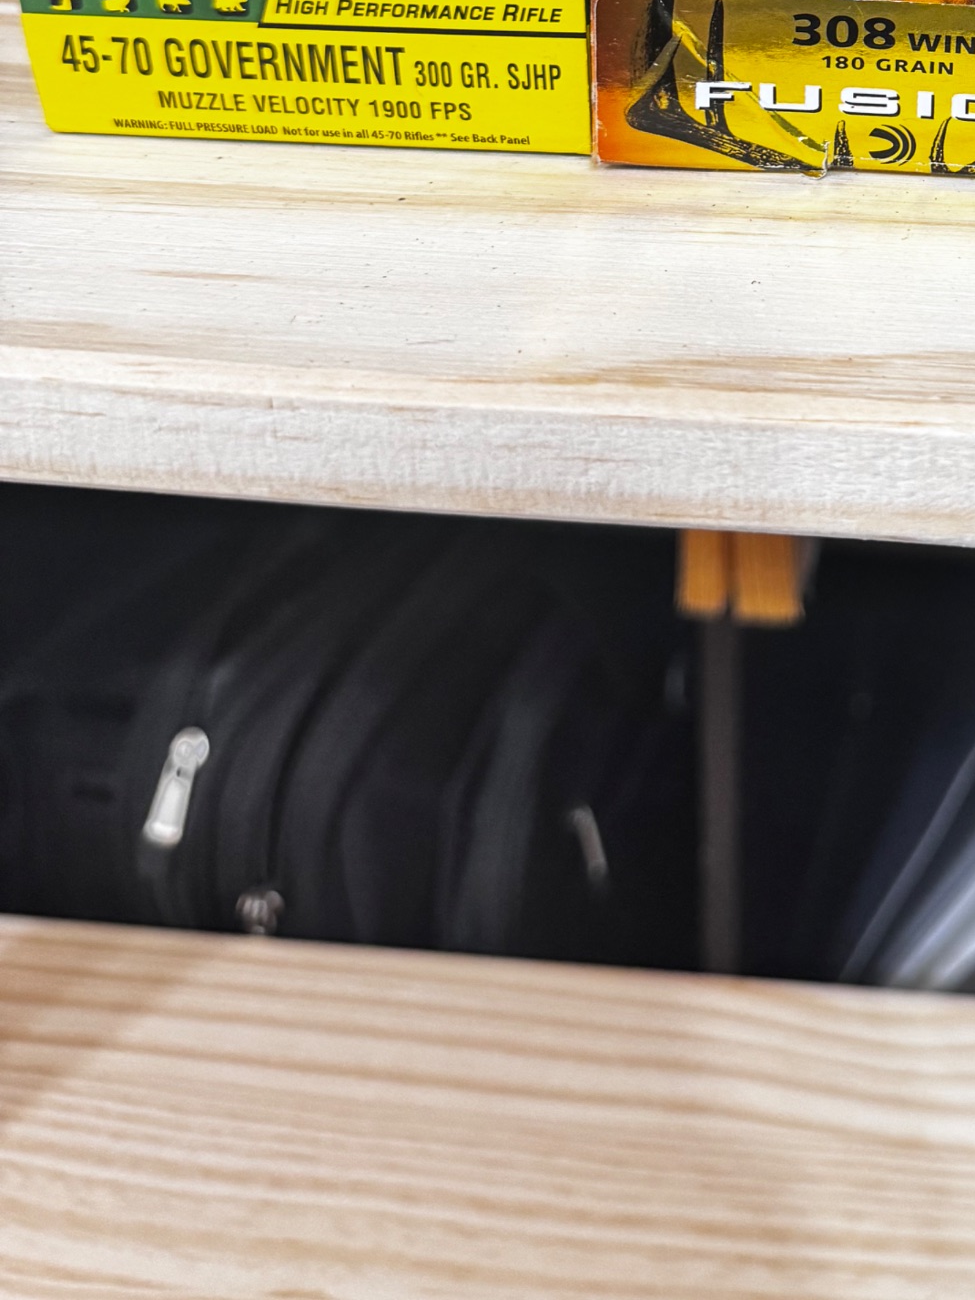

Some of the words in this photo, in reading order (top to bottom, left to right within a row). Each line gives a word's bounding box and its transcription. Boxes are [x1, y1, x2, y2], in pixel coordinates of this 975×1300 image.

[502, 4, 563, 23] RIFLE
[792, 13, 896, 50] 308
[61, 34, 154, 76] 45-70
[163, 37, 406, 86] GOVERNMENT
[414, 60, 453, 88] 300
[461, 61, 499, 89] GR.
[507, 63, 562, 91] SJHP
[822, 56, 865, 70] 180
[876, 58, 954, 75] GRAIN
[158, 90, 247, 112] MUZZLE
[253, 94, 360, 117] VELOCITY
[369, 100, 422, 119] 1900
[431, 102, 473, 121] FPS
[113, 118, 168, 130] WARNING:
[170, 121, 195, 131] FULL
[196, 122, 250, 133] PRESSURE
[251, 124, 278, 135] LOAD
[283, 126, 301, 136] Not
[303, 126, 320, 137] for
[322, 128, 341, 138] use
[342, 128, 353, 139] in
[355, 128, 370, 140] all
[371, 129, 402, 141] 45-70
[404, 131, 434, 142] Rifles
[450, 133, 469, 144] See
[472, 134, 498, 144] Back
[500, 134, 531, 146] Panel
